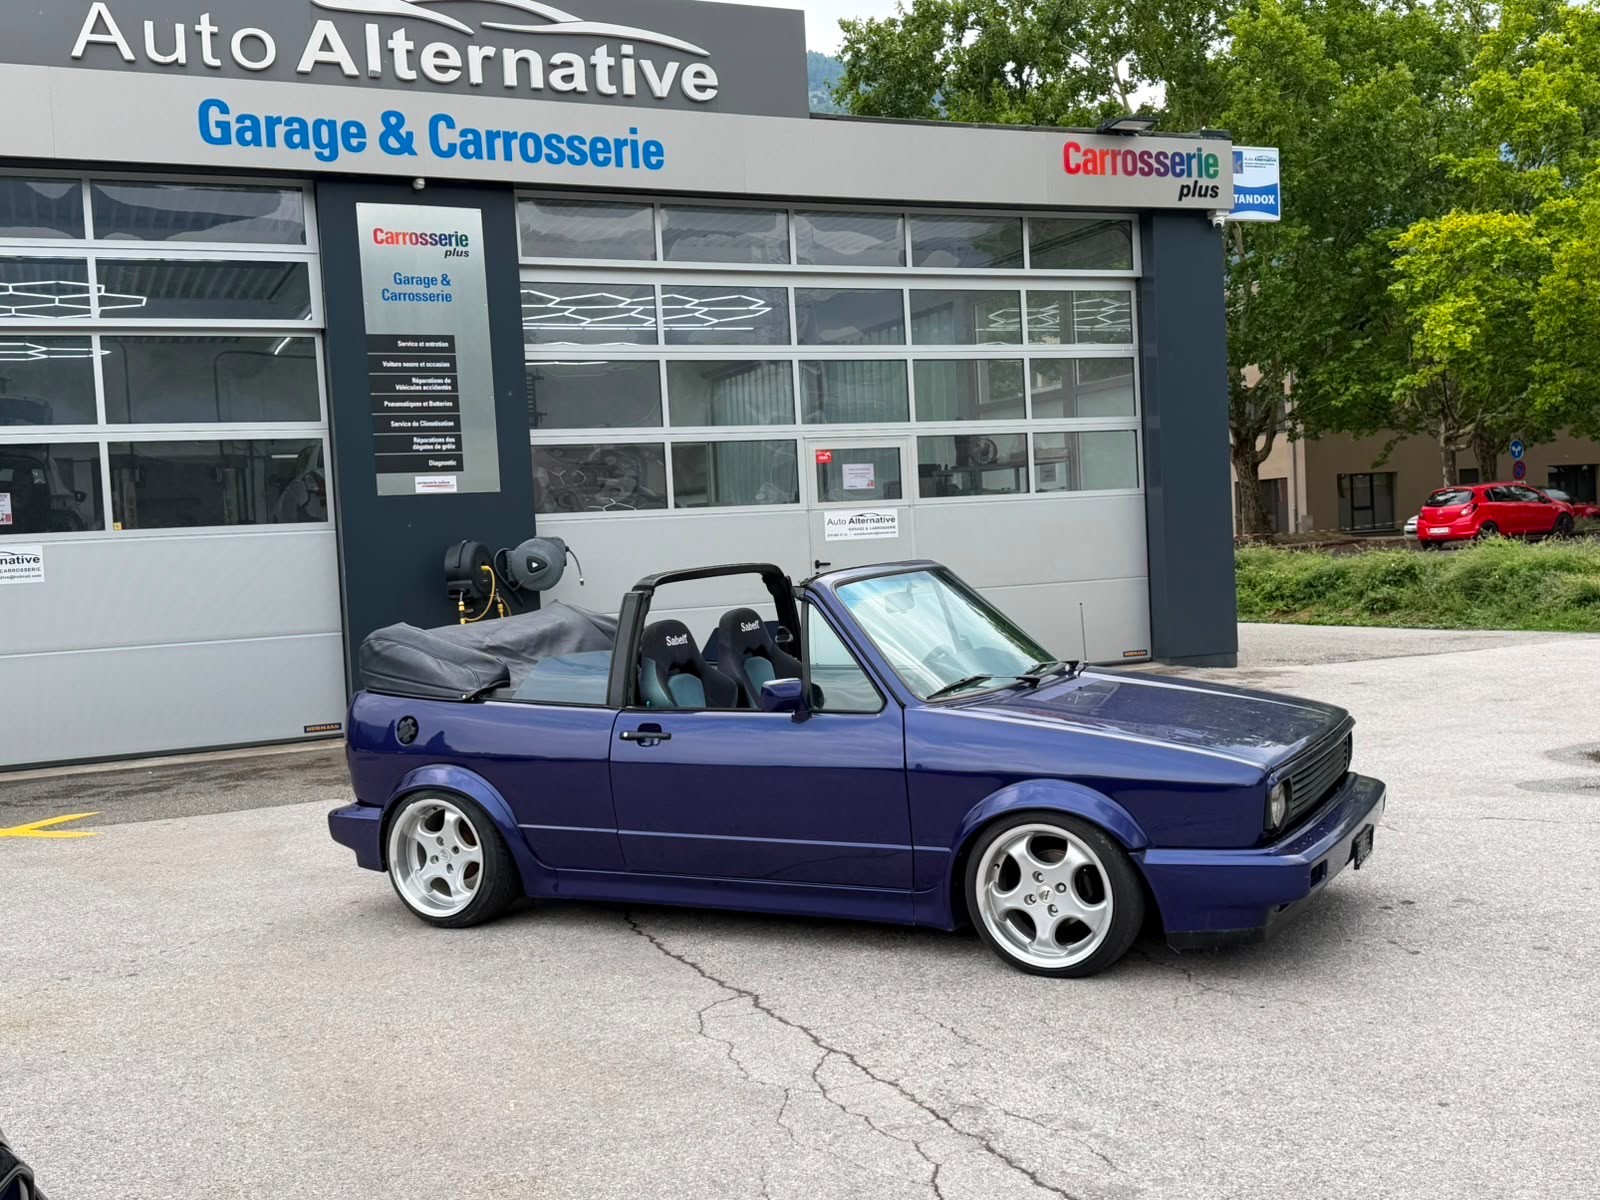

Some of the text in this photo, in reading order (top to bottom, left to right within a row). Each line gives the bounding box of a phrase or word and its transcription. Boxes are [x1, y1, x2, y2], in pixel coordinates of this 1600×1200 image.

[70, 1, 719, 103] Auto Alternative
[198, 98, 665, 171] Garage & Carrosserie
[1063, 141, 1219, 180] Carrosserie
[1178, 180, 1220, 201] plus
[373, 227, 469, 248] Carrosserie
[444, 248, 470, 259] plus
[393, 272, 451, 288] Garage &
[381, 288, 452, 303] Carrosserie
[384, 400, 422, 408] Pneumatiques
[827, 516, 896, 526] Auto Alternative
